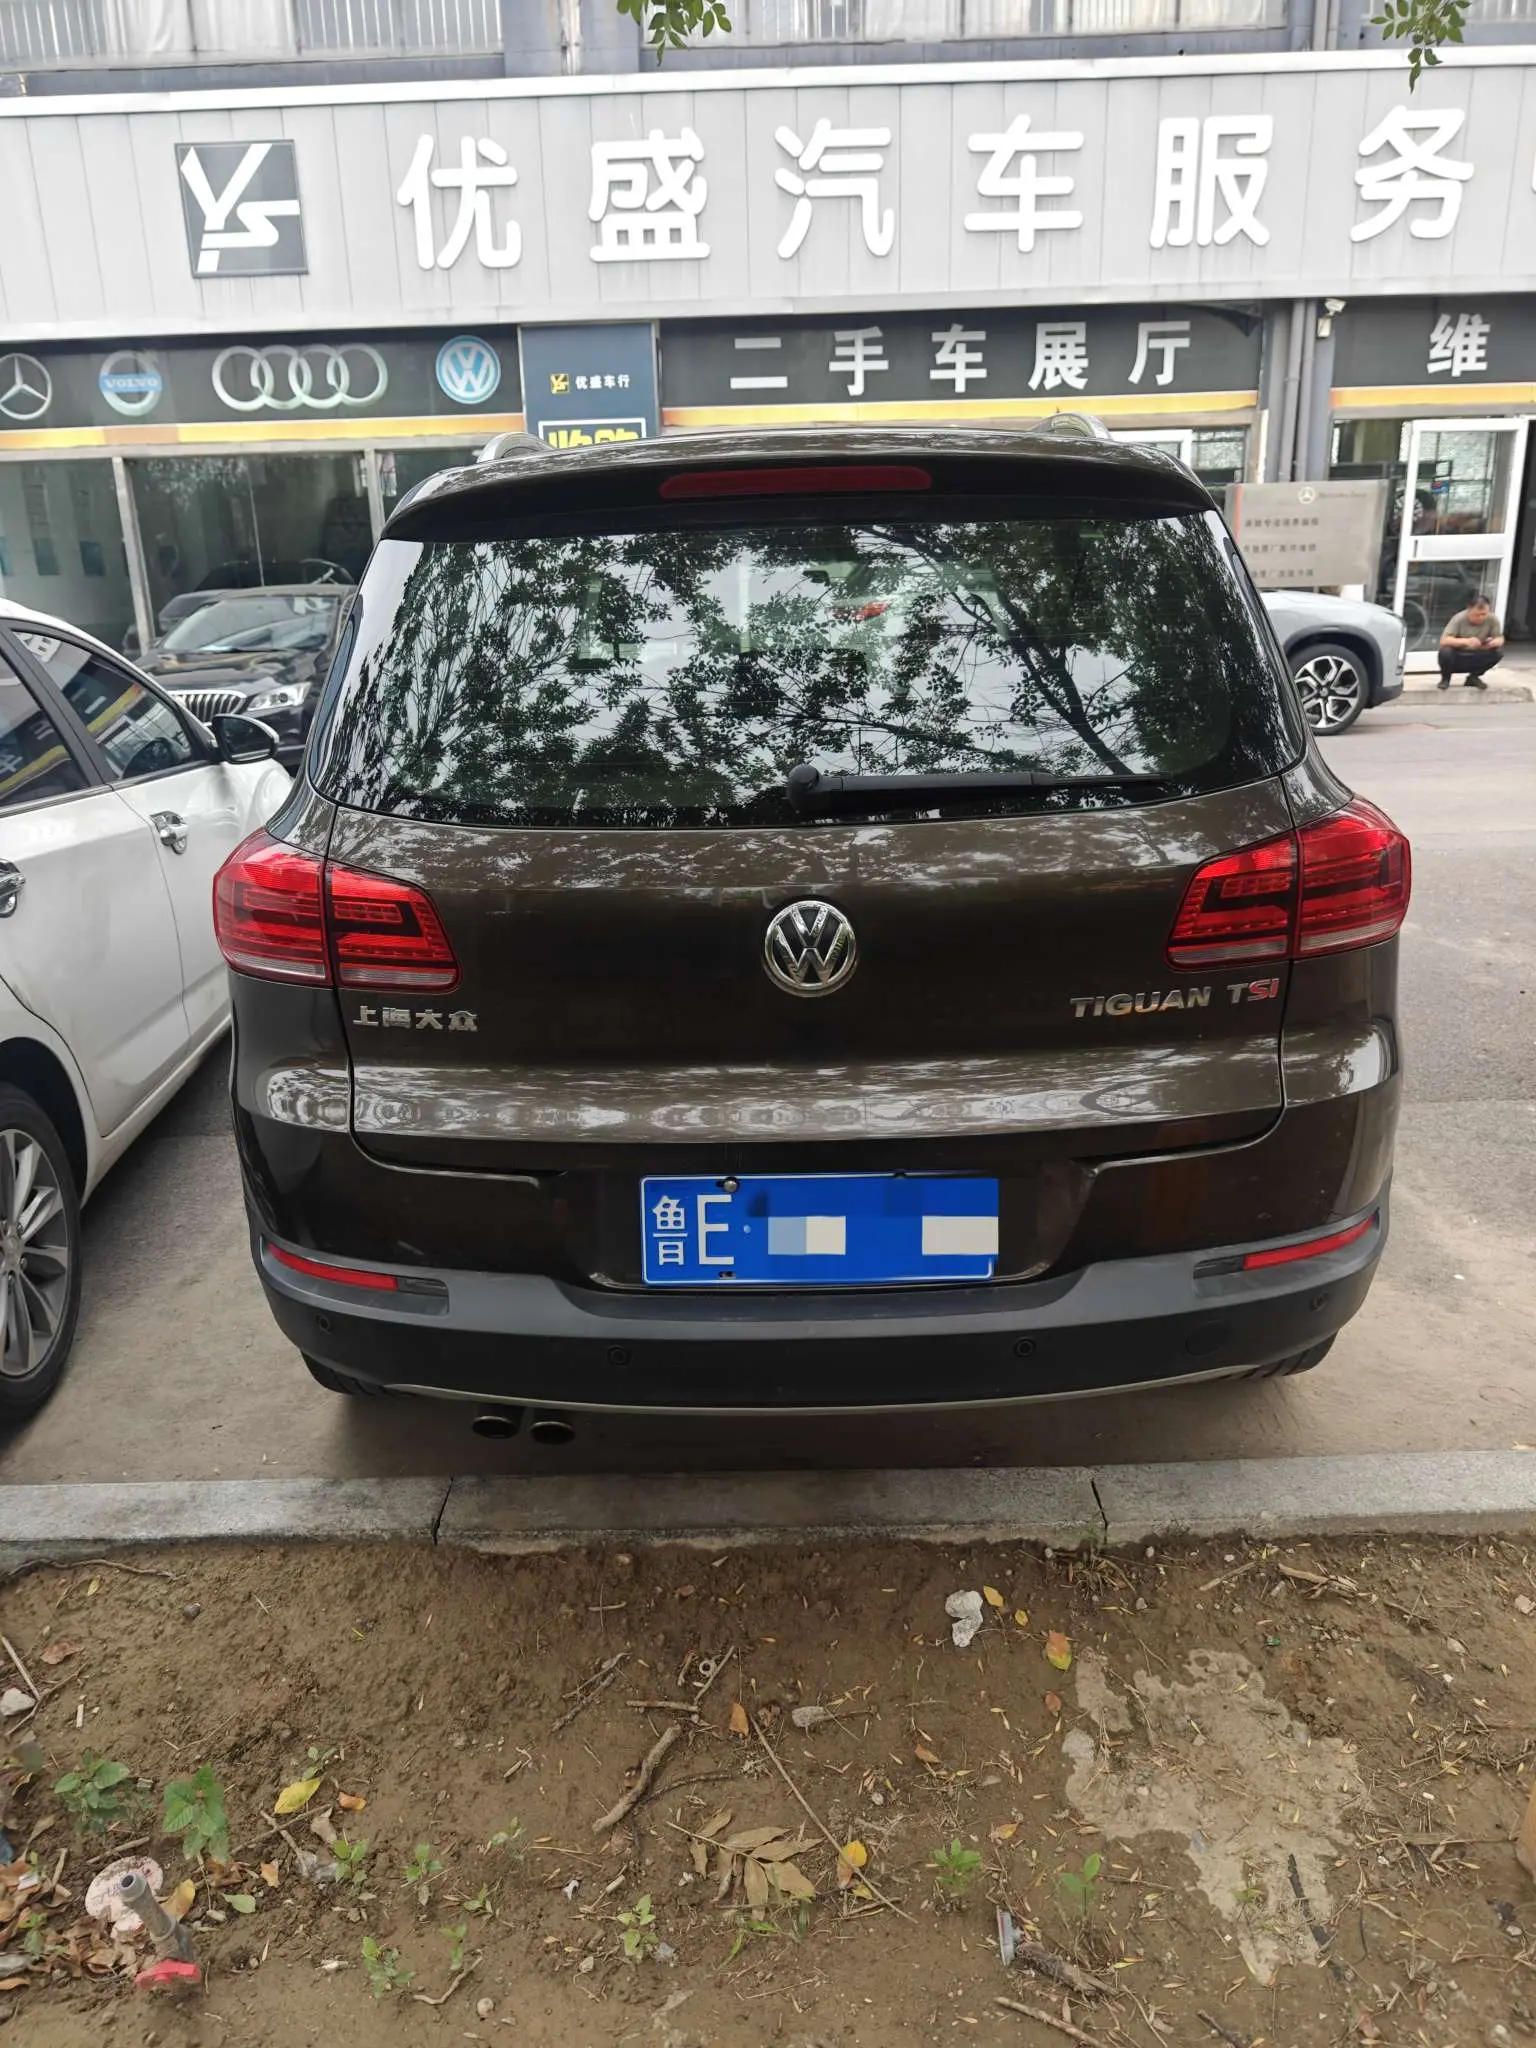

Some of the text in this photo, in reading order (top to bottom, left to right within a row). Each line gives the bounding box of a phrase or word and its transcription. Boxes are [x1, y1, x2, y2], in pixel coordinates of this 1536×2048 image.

[398, 105, 1536, 270] 优盛汽车服务
[730, 321, 1191, 396] 二手车展厅
[1427, 313, 1491, 377] 维
[103, 377, 159, 389] VOLVO
[352, 1005, 478, 1032] 上海大众
[1070, 978, 1280, 1018] TIGUAN TSI
